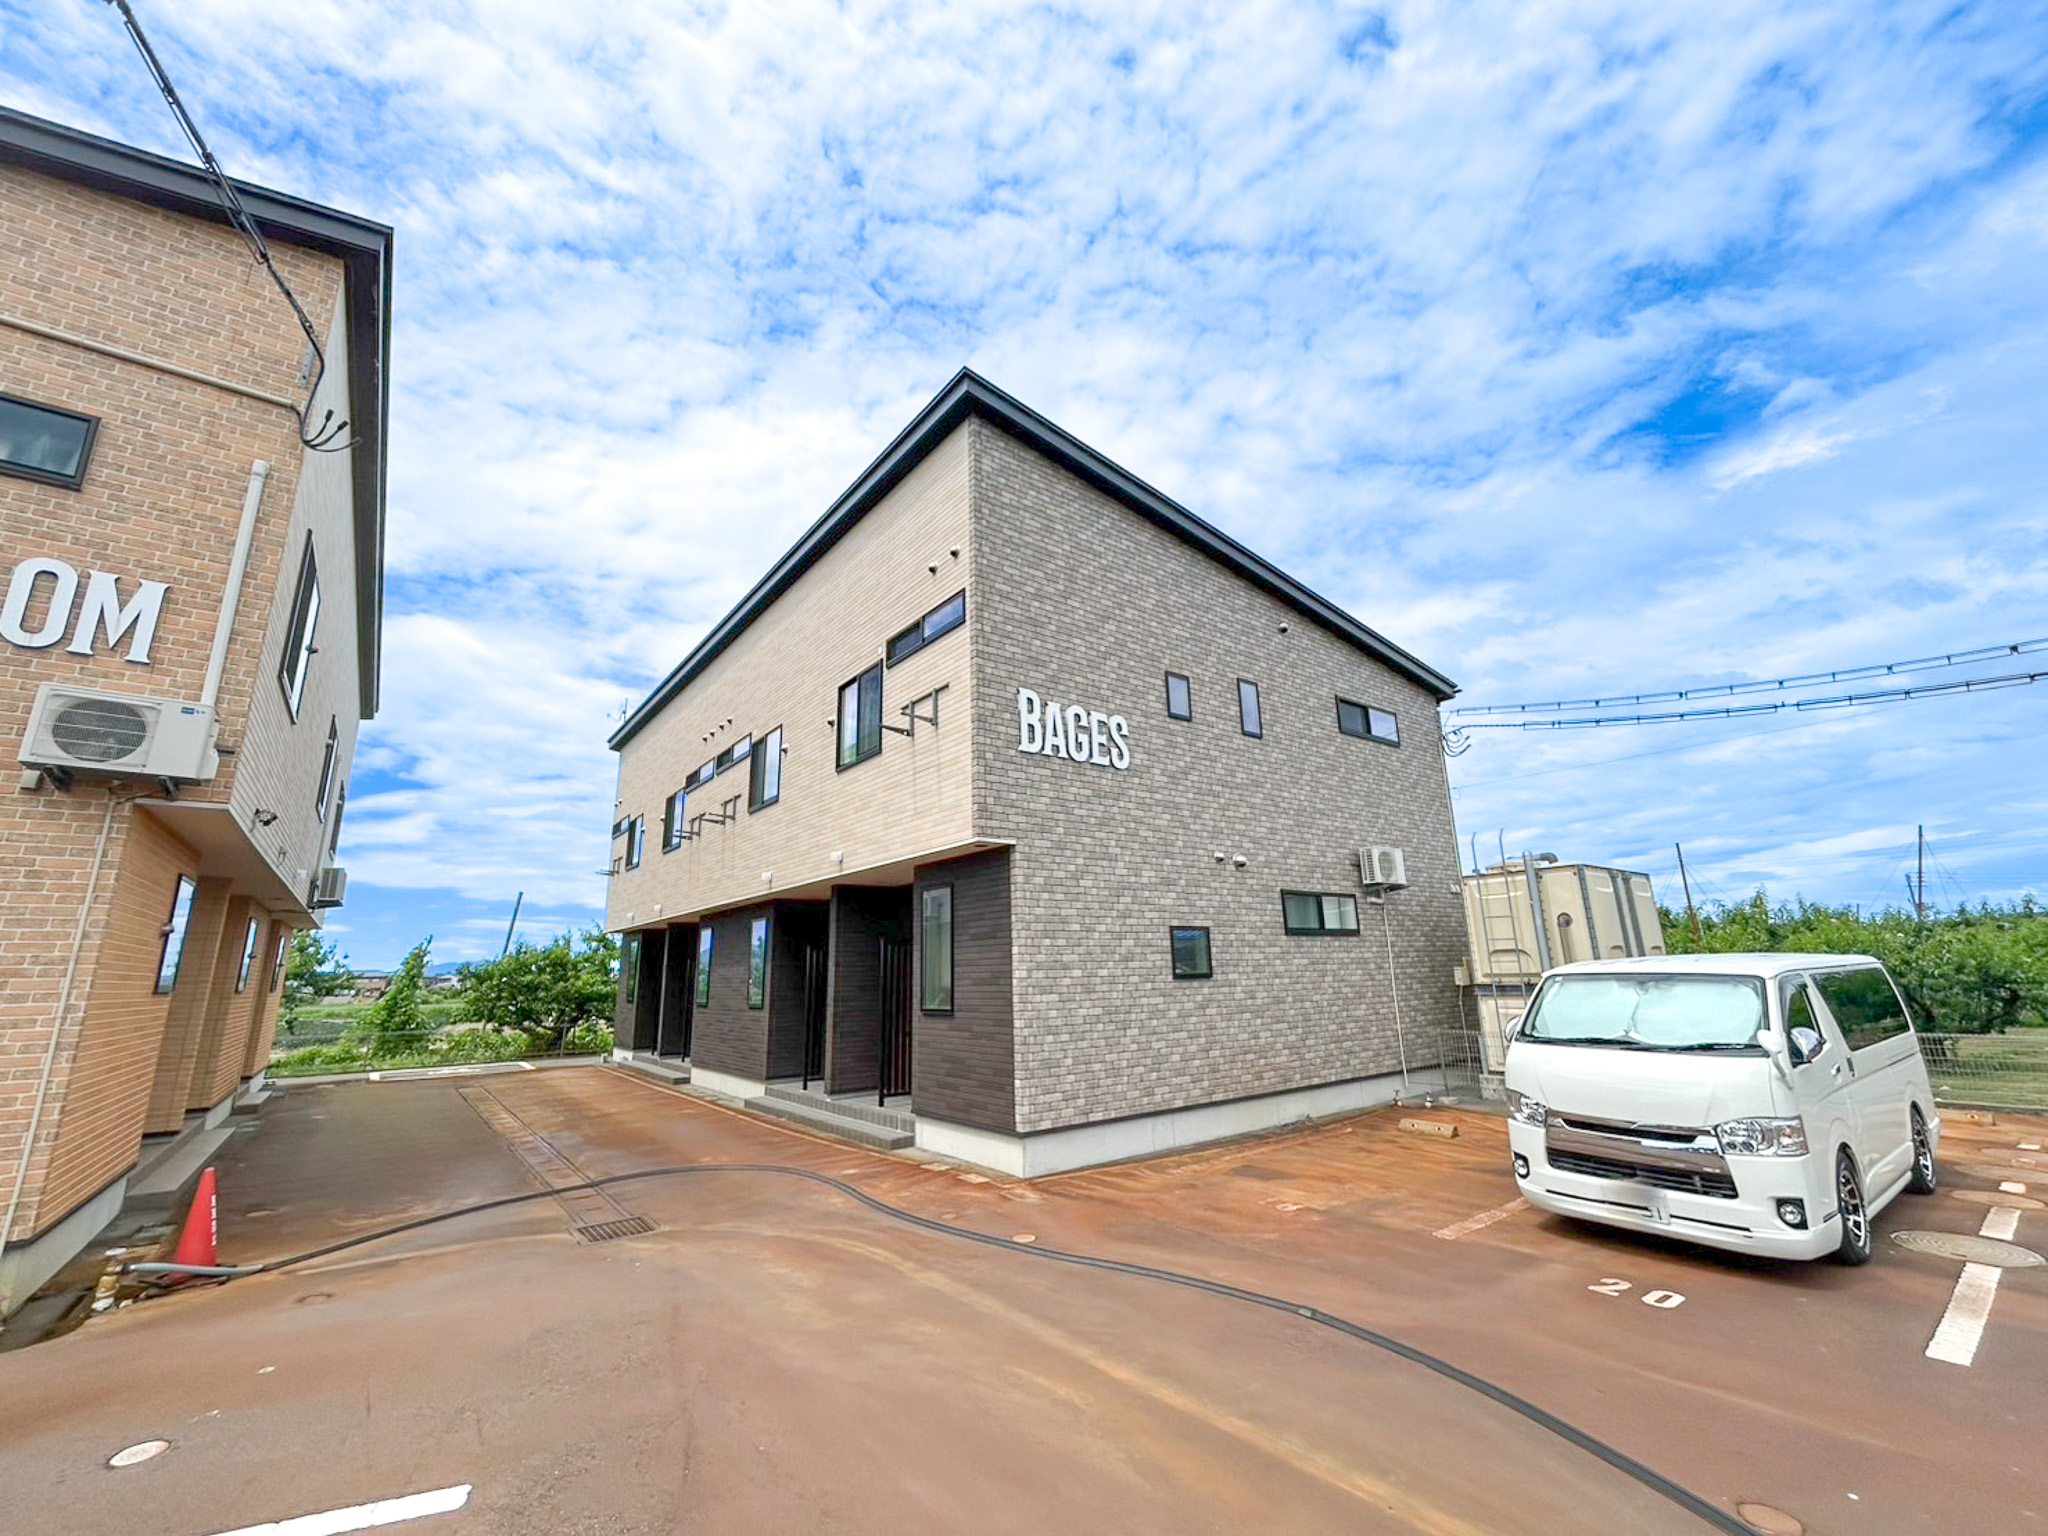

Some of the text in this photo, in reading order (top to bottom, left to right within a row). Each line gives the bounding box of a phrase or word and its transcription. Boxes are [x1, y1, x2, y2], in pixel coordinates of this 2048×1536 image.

[0, 557, 171, 664] OM
[1017, 687, 1132, 770] BAGES
[1587, 1277, 1686, 1309] 20
